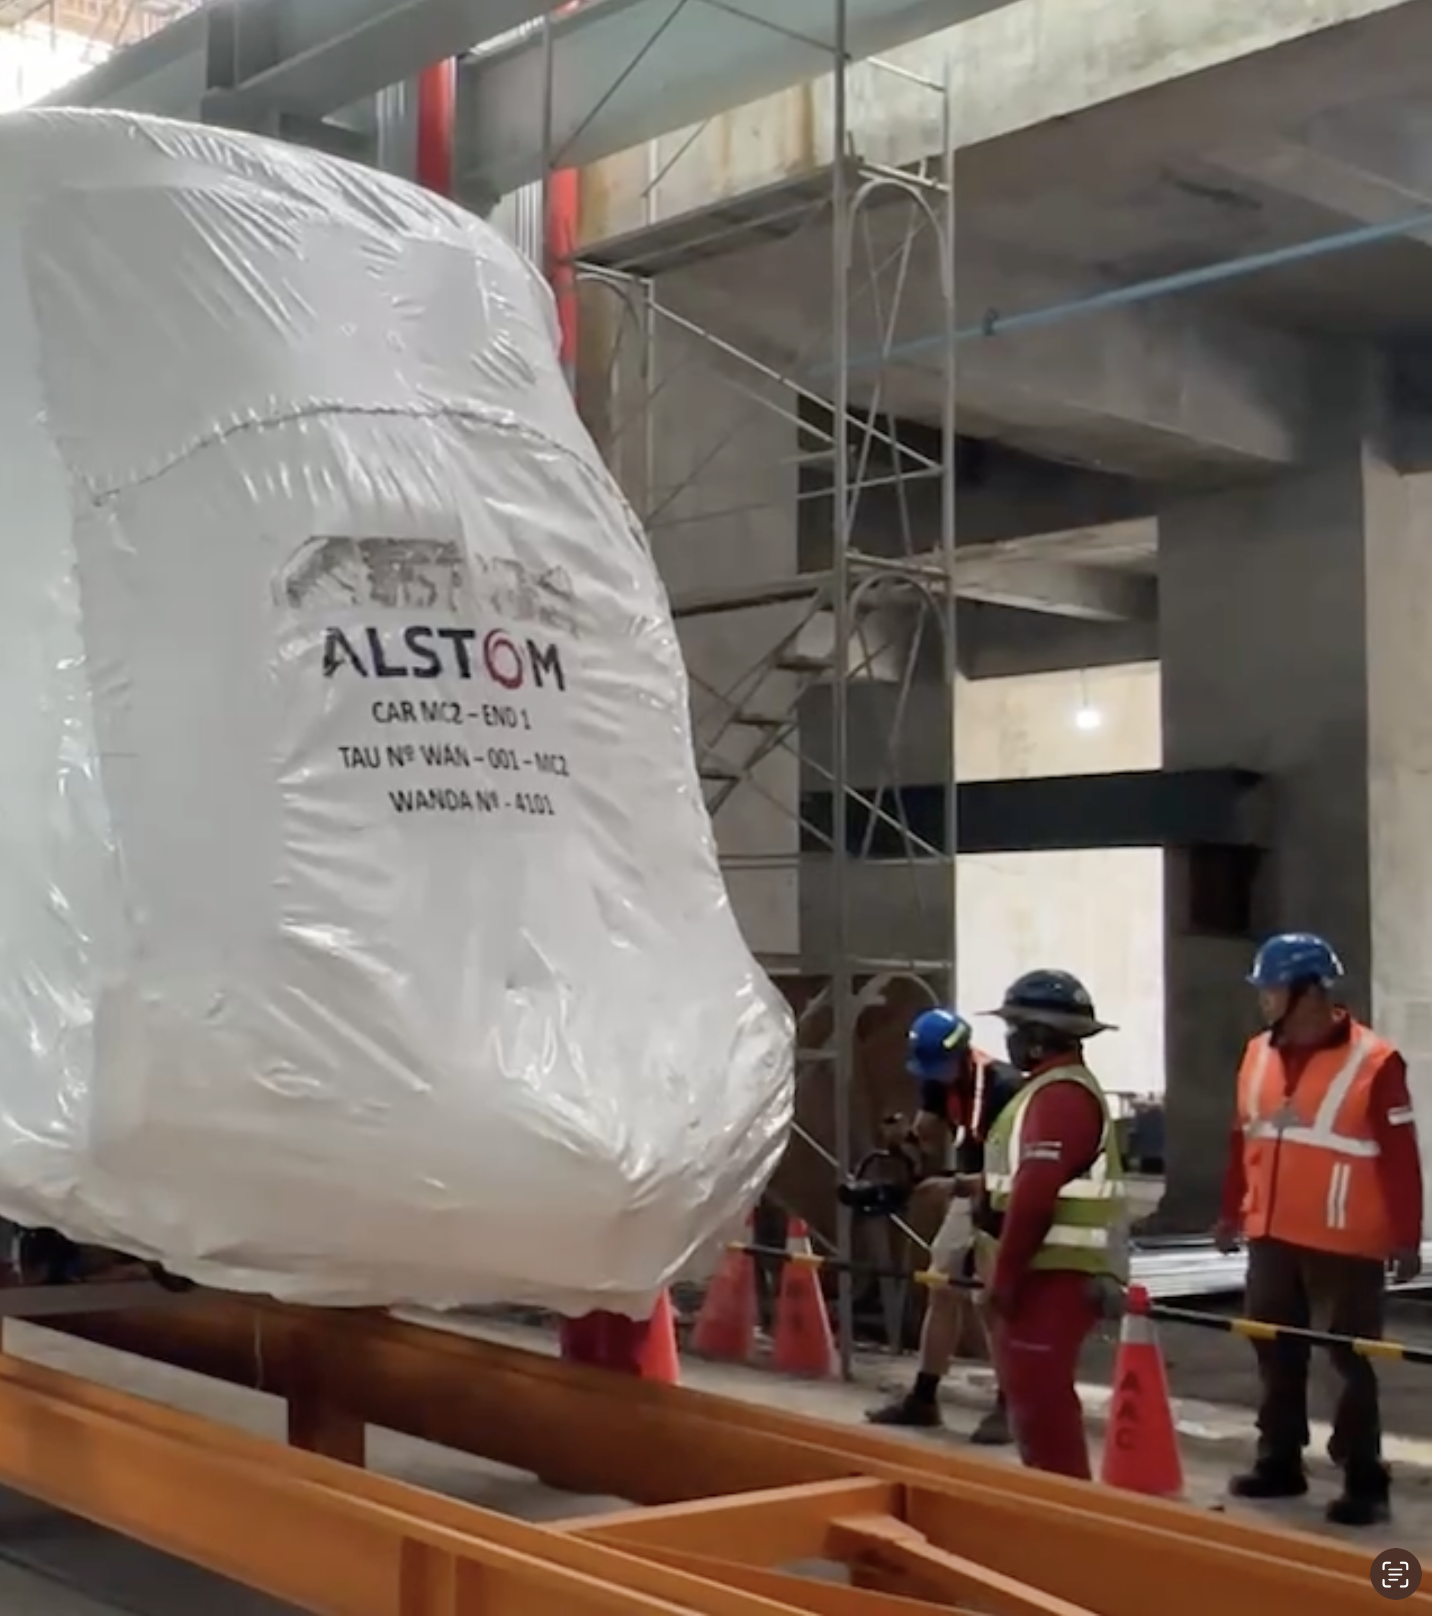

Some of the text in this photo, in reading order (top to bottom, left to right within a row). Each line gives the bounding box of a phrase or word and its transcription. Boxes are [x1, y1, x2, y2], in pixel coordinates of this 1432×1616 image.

[323, 625, 566, 692] ALSTOM
[372, 701, 417, 724] CAR
[420, 700, 464, 725] MC2
[482, 704, 518, 729] END
[521, 708, 532, 730] 1
[338, 746, 381, 769] TAU
[420, 744, 471, 768] WAN
[487, 747, 520, 771] 001
[534, 752, 570, 777] MC2
[388, 788, 473, 814] WANDA
[515, 792, 556, 815] 4101
